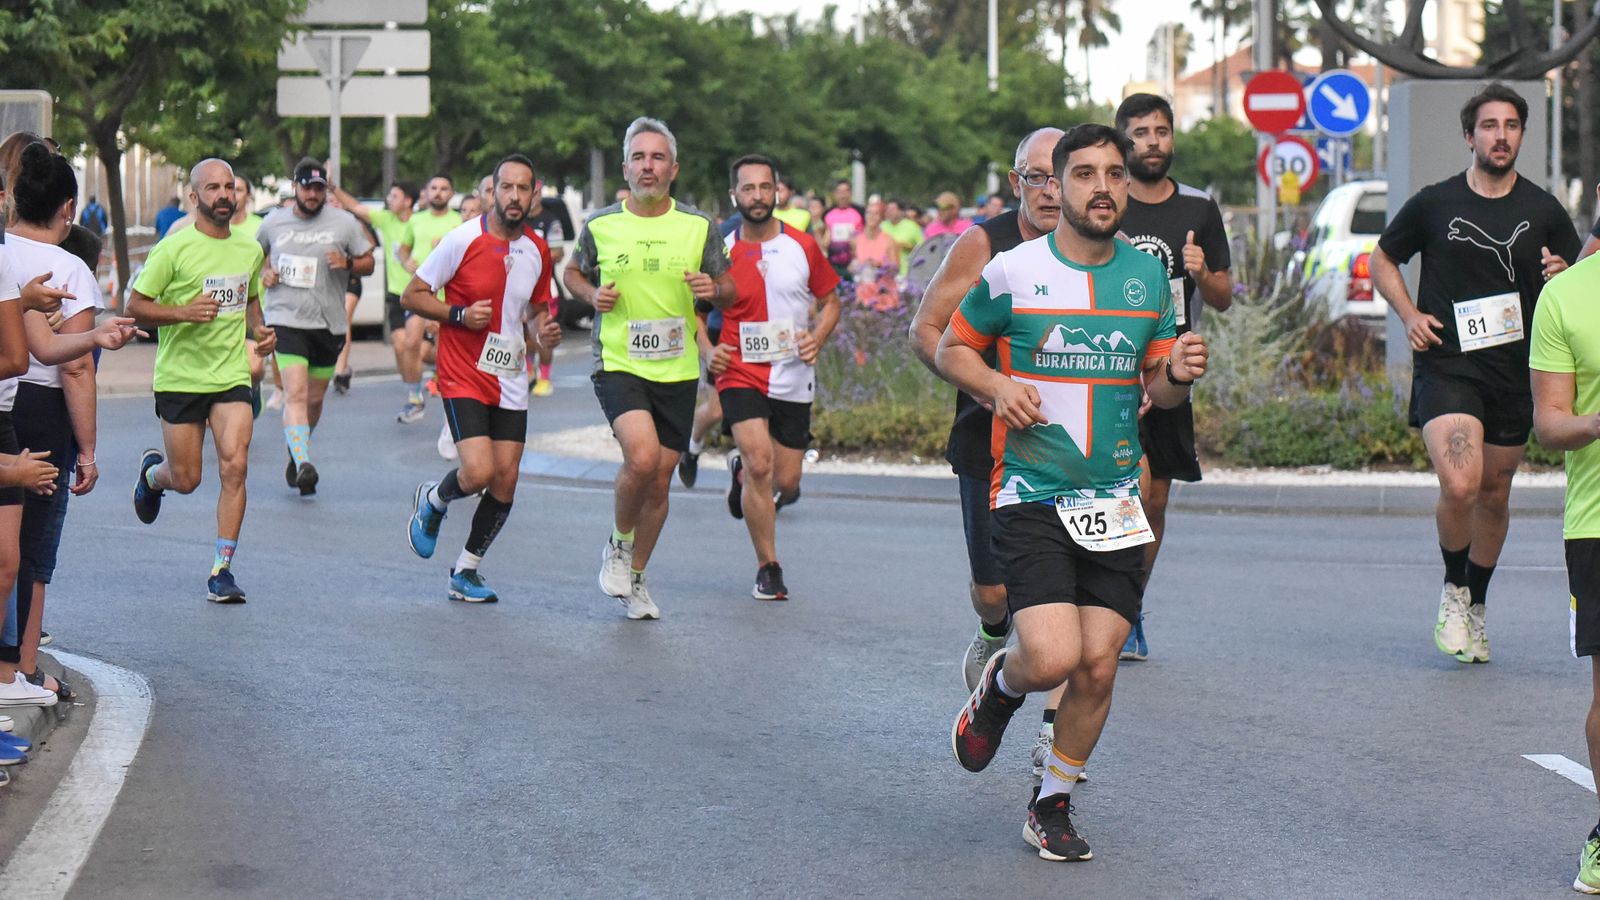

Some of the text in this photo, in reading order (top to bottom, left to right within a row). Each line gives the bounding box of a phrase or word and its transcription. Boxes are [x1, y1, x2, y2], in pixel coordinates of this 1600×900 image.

[1272, 157, 1306, 175] 30
[210, 289, 234, 303] 739
[1467, 316, 1487, 336] 81
[632, 334, 660, 349] 460
[745, 337, 769, 351] 589
[486, 348, 512, 366] 609
[1035, 353, 1106, 370] EURAFRICA
[1069, 511, 1108, 536] 125
